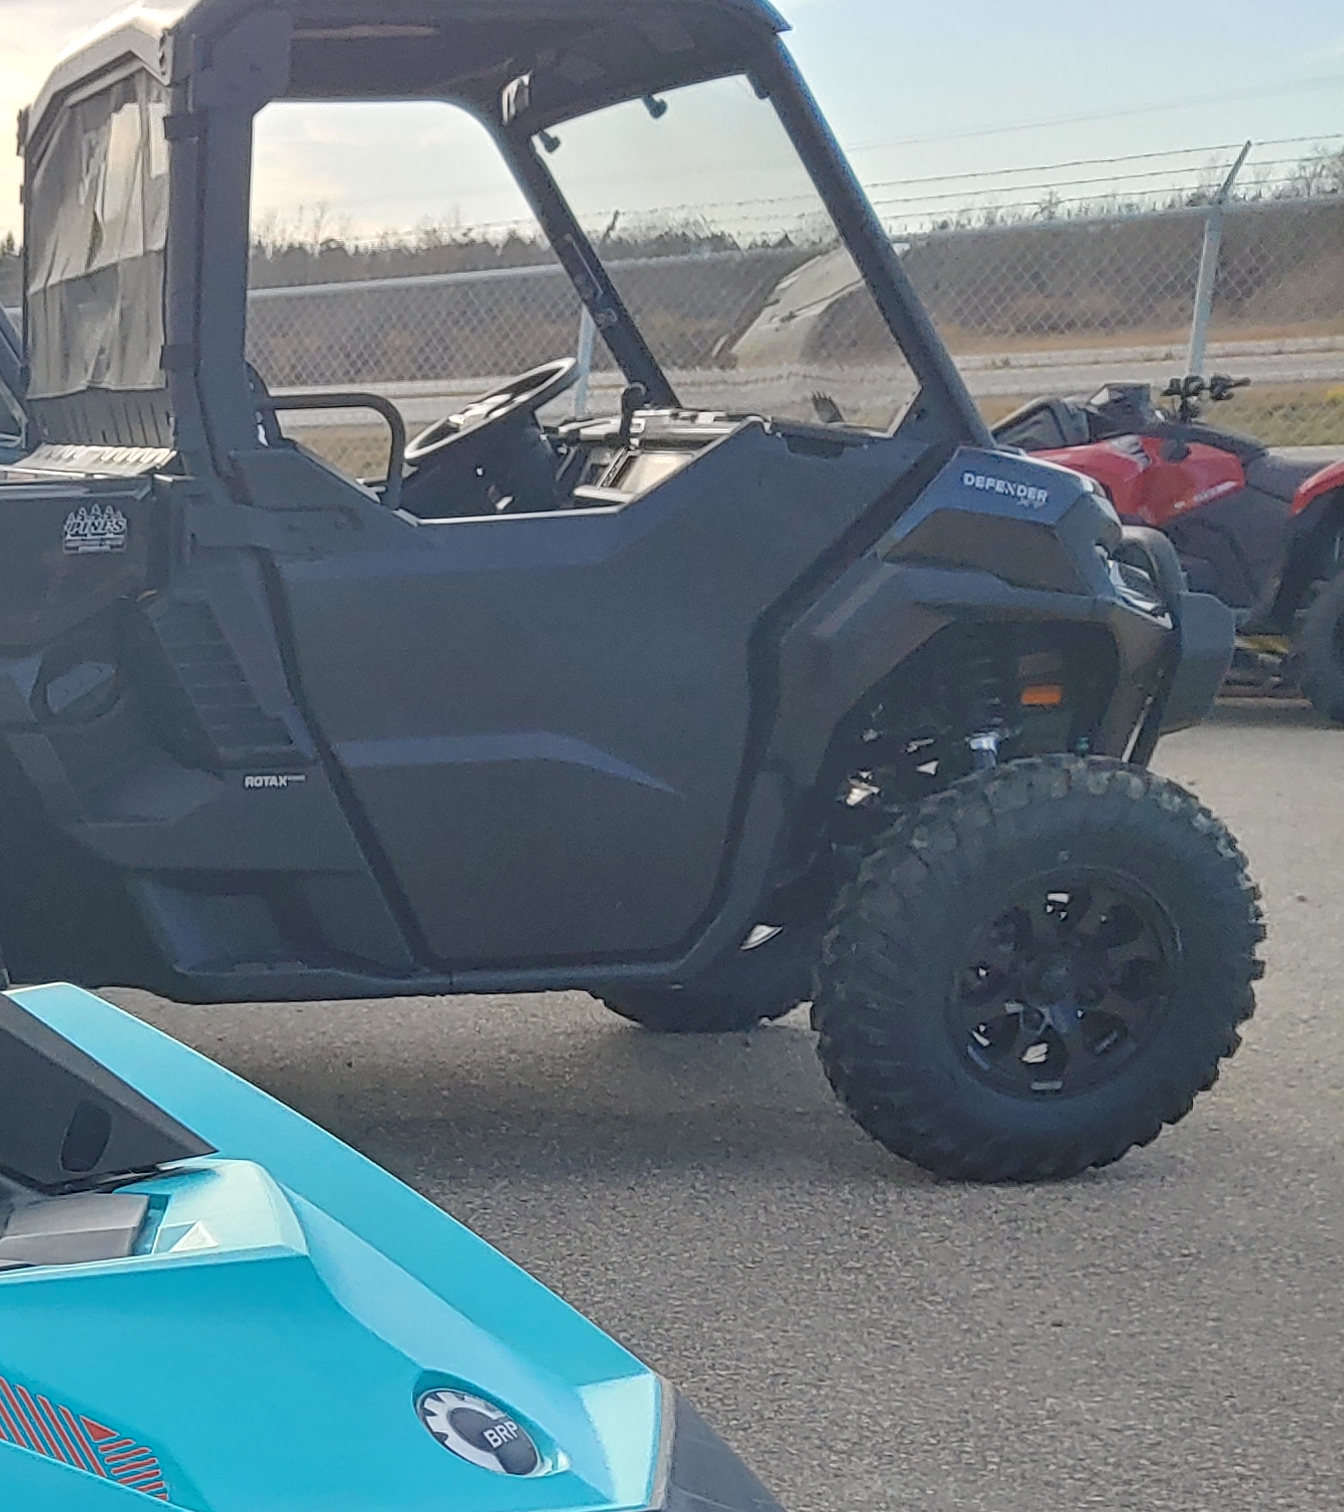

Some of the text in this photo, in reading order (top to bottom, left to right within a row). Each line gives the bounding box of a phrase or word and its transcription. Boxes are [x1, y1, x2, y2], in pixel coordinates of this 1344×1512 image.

[963, 472, 1048, 503] DEFENDER
[244, 775, 288, 789] ROTAX
[483, 1421, 518, 1448] BRP
